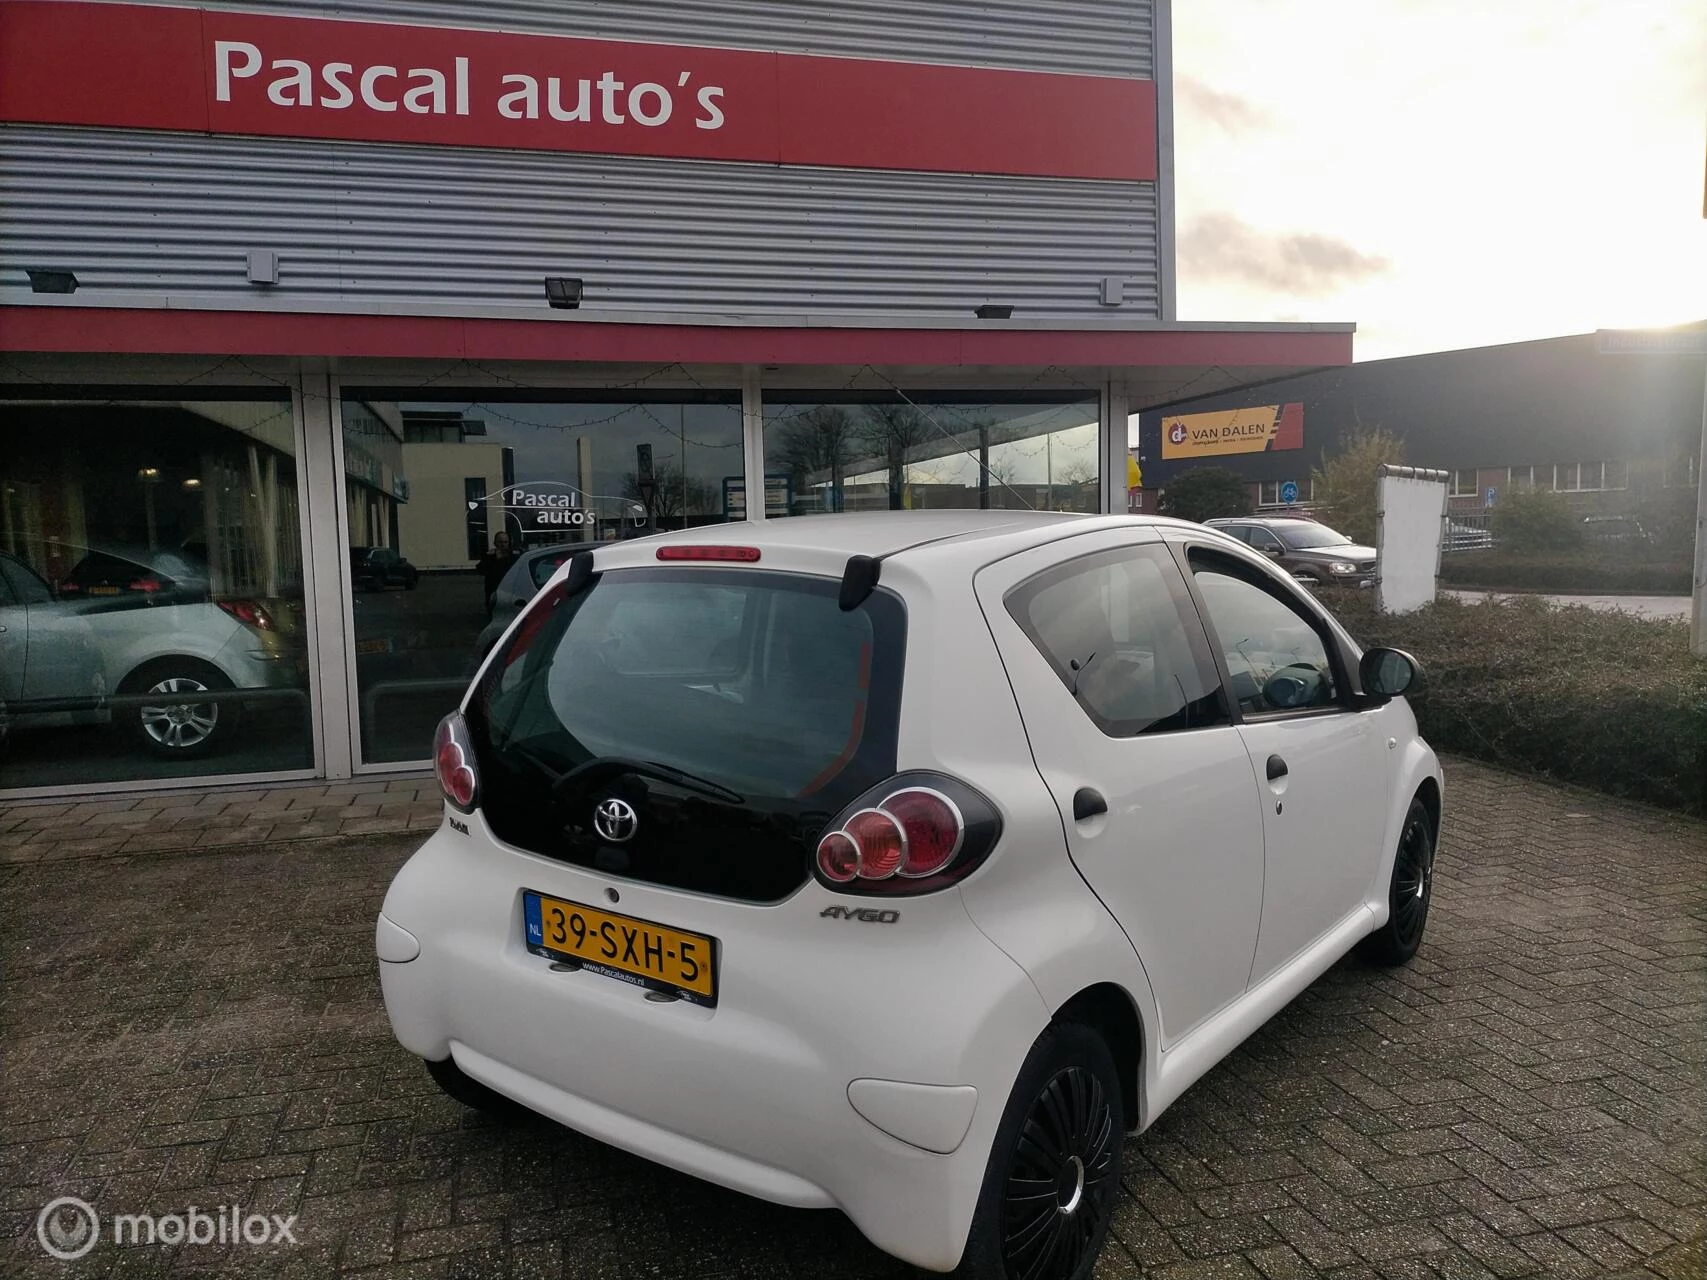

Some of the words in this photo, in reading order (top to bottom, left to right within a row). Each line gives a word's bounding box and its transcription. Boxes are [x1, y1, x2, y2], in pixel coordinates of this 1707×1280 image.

[215, 40, 469, 115] Pascal
[497, 71, 725, 129] auto's
[1192, 428, 1218, 440] VAN
[1222, 423, 1265, 437] DALEN
[512, 489, 576, 508] Pascal
[536, 509, 596, 525] auto's
[819, 904, 901, 923] AYGO
[529, 923, 542, 937] NL
[551, 907, 699, 982] 39-SXH-5
[582, 962, 645, 987] www.Pascalautos.nl
